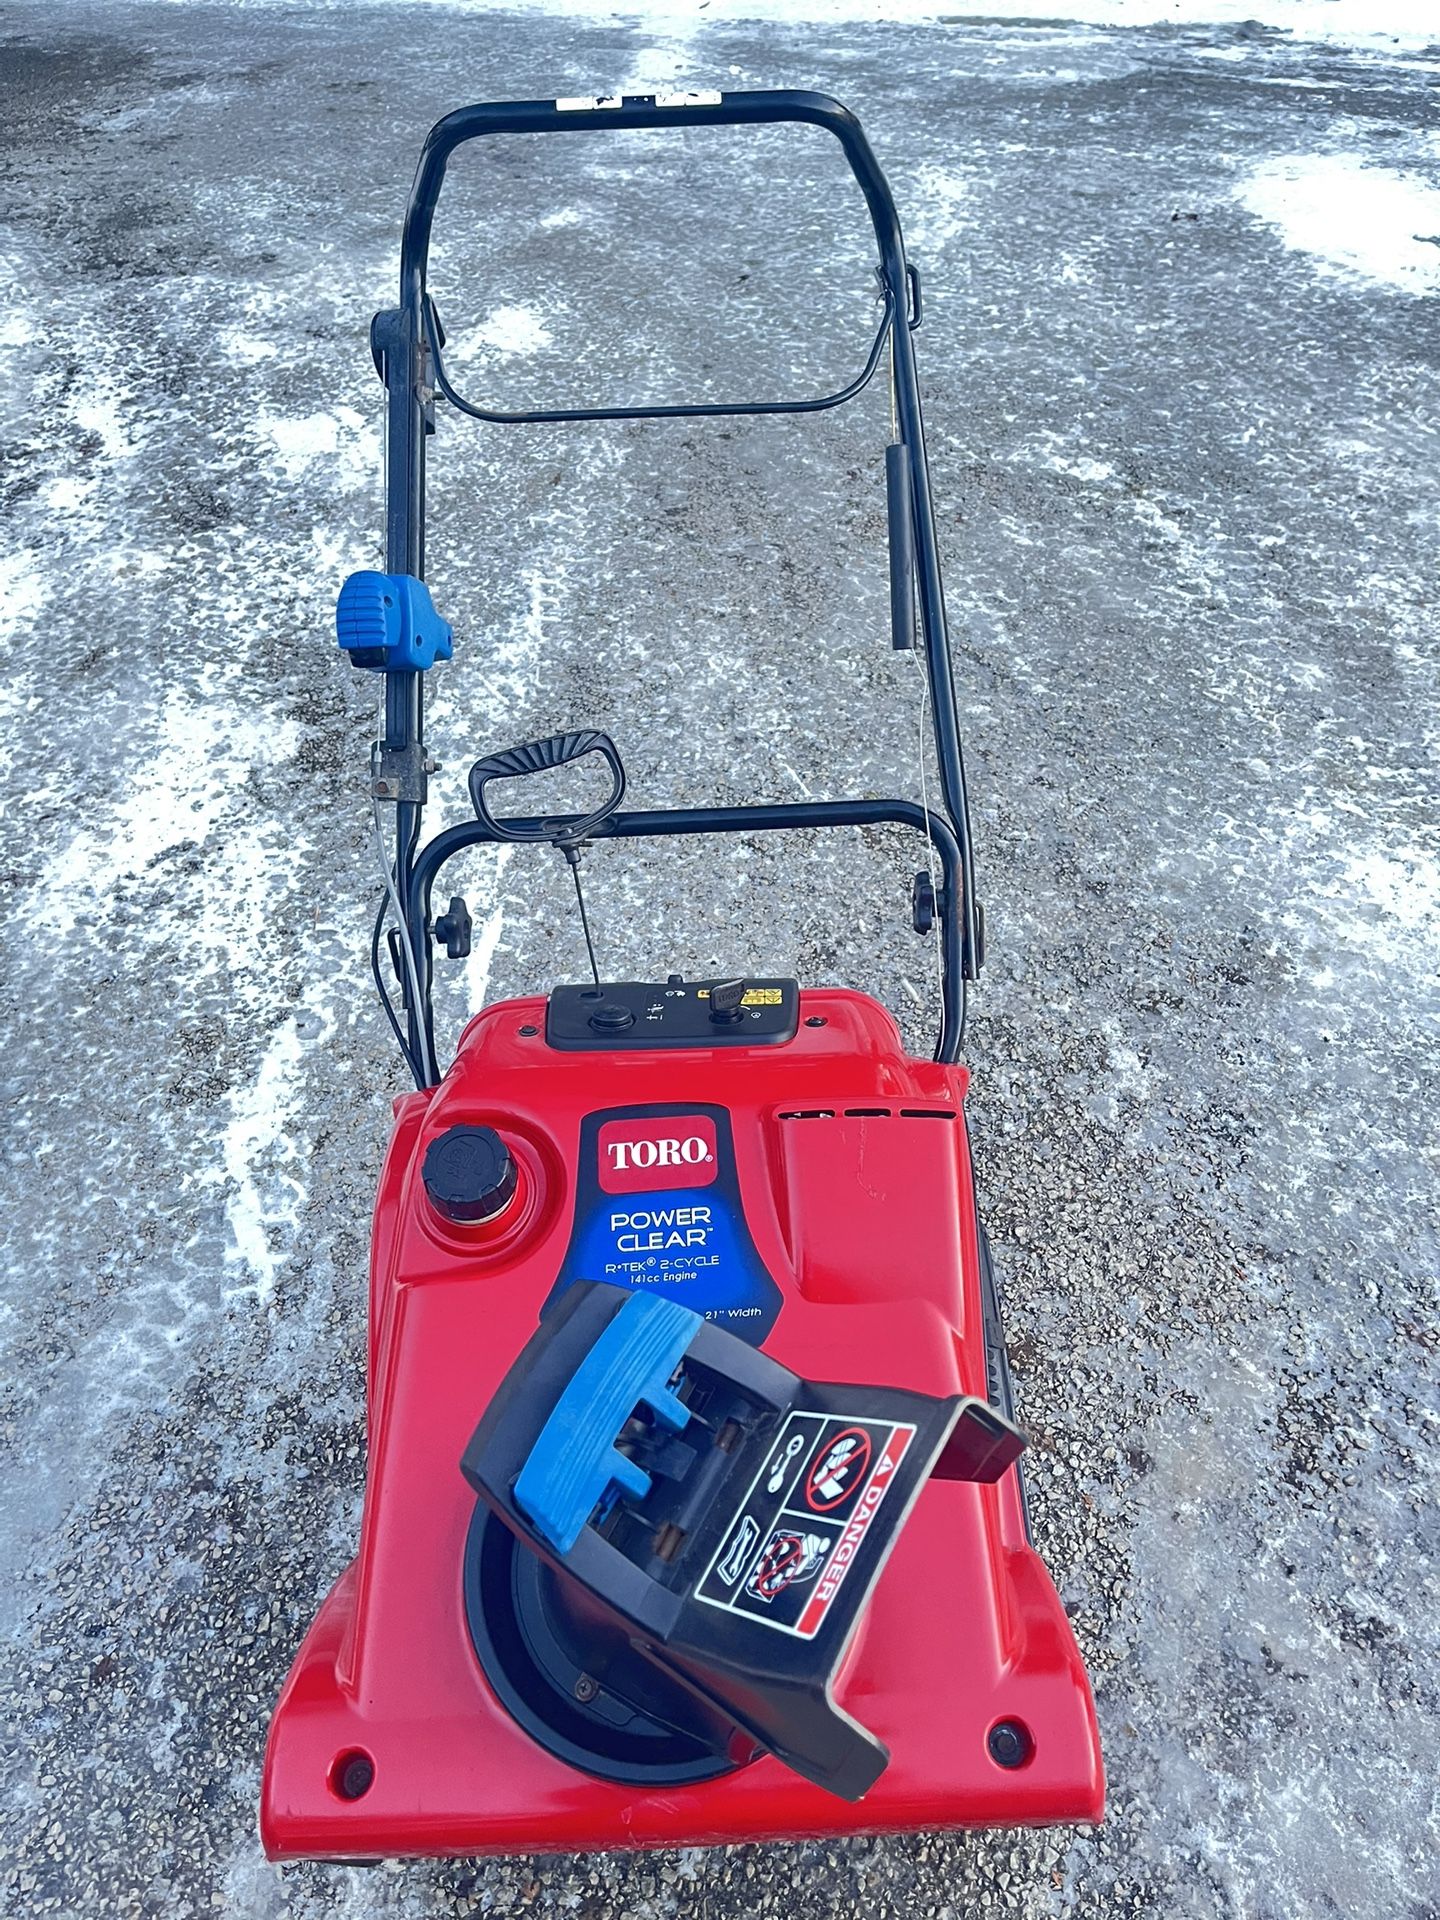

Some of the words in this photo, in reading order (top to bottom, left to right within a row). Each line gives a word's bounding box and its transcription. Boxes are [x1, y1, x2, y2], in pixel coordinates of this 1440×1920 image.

[610, 1206, 712, 1232] POWER
[660, 1255, 720, 1269] 2-CYCLE
[630, 1273, 660, 1284] 141cc
[663, 1271, 698, 1283] Engine
[728, 1307, 762, 1318] Width
[815, 1486, 883, 1600] DANGER
